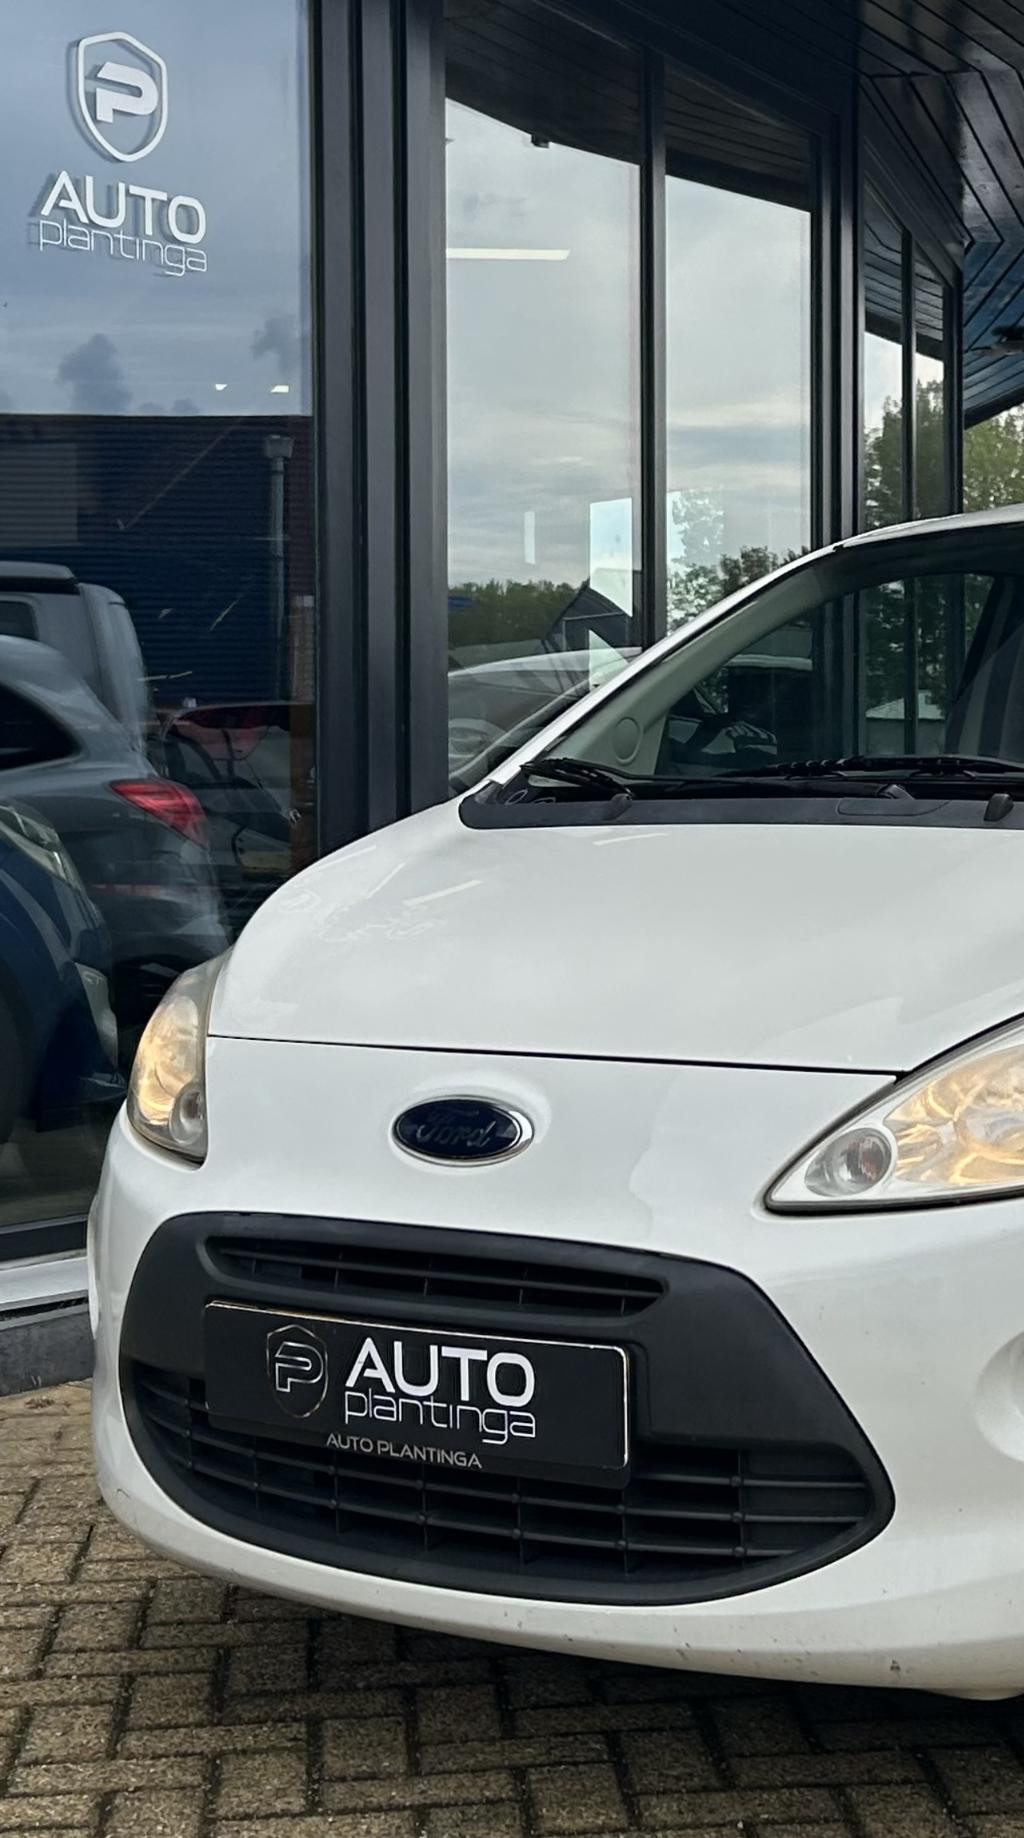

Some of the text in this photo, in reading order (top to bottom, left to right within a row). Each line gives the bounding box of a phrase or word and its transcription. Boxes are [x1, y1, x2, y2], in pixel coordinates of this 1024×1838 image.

[40, 170, 207, 245] AUTO
[39, 218, 208, 277] plantinga
[415, 1107, 497, 1148] Ford
[345, 1336, 536, 1408] AUTO
[344, 1387, 537, 1445] plantinga
[326, 1432, 483, 1470] AUTO PLANTINGA
